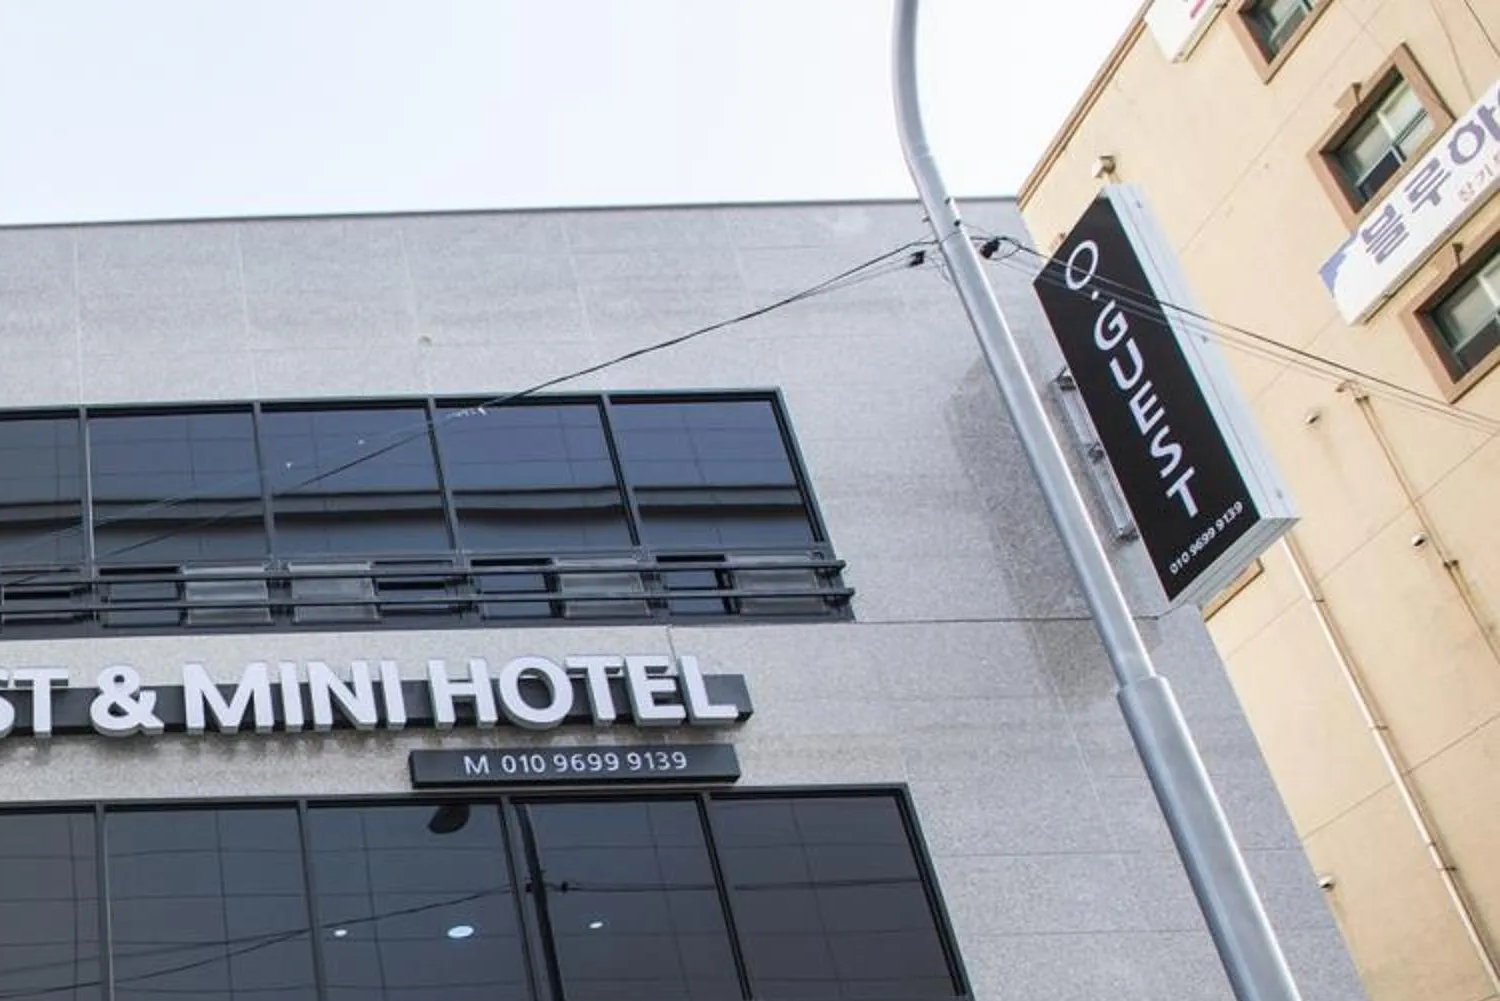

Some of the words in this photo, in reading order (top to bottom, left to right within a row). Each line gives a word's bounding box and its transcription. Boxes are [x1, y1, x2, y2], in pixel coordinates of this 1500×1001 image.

[1169, 551, 1190, 575] 010
[90, 664, 164, 737] &
[183, 658, 407, 736] MINI
[426, 653, 739, 731] HOTEL
[463, 755, 489, 776] M
[501, 753, 546, 775] 010
[552, 752, 620, 773] 9699
[626, 750, 688, 771] 9139
